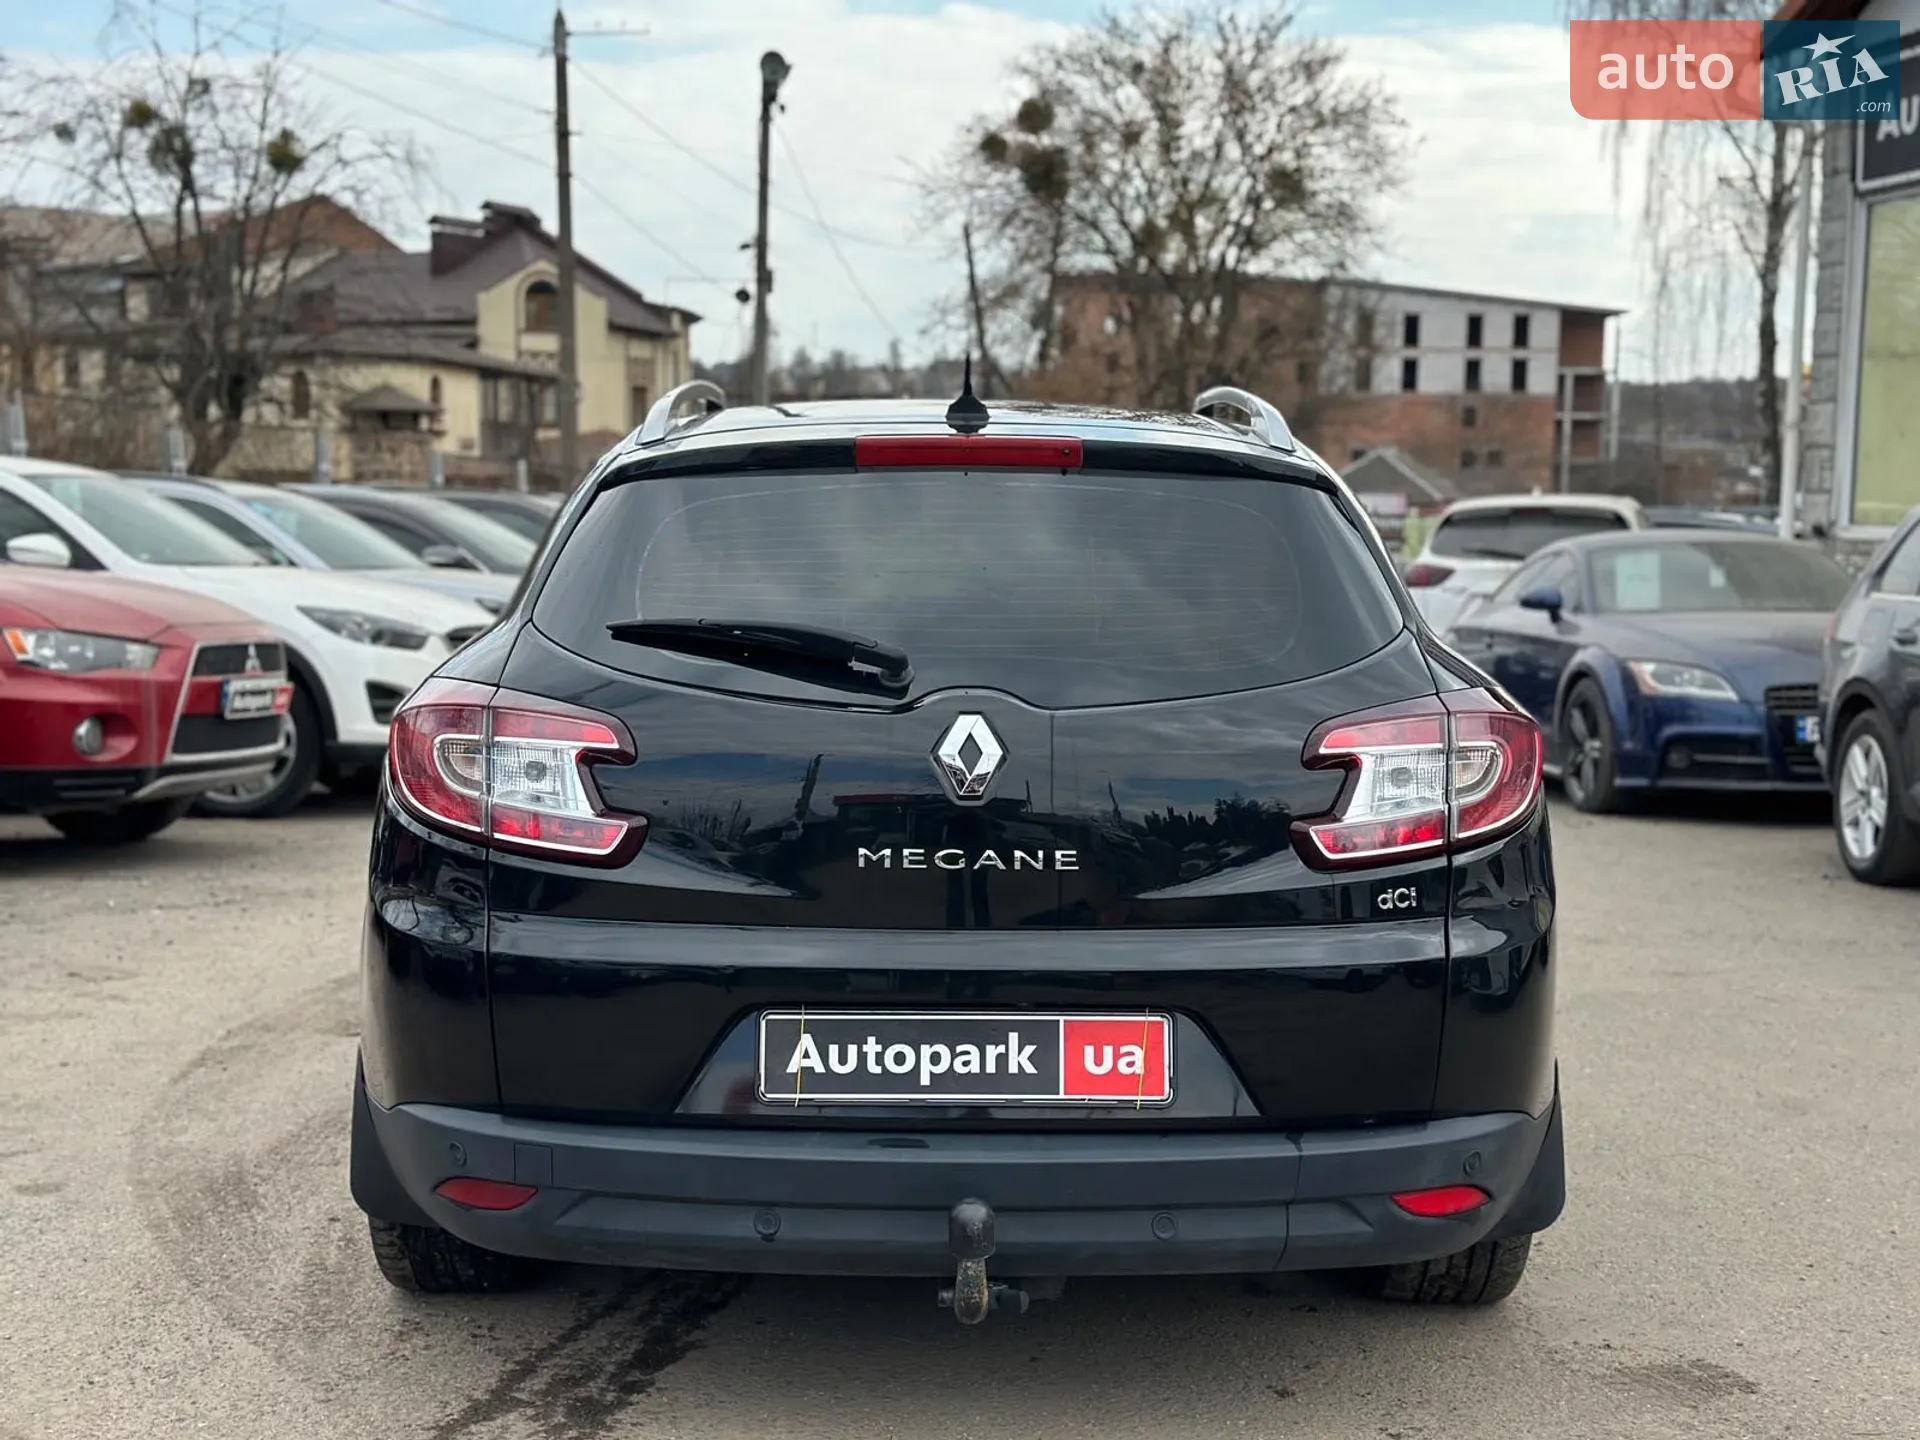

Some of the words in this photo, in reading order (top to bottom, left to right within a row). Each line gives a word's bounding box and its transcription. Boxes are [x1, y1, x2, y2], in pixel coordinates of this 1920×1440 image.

[857, 847, 1080, 871] MEGANE
[786, 1032, 1038, 1086] Autopark
[1083, 1043, 1145, 1076] ua
